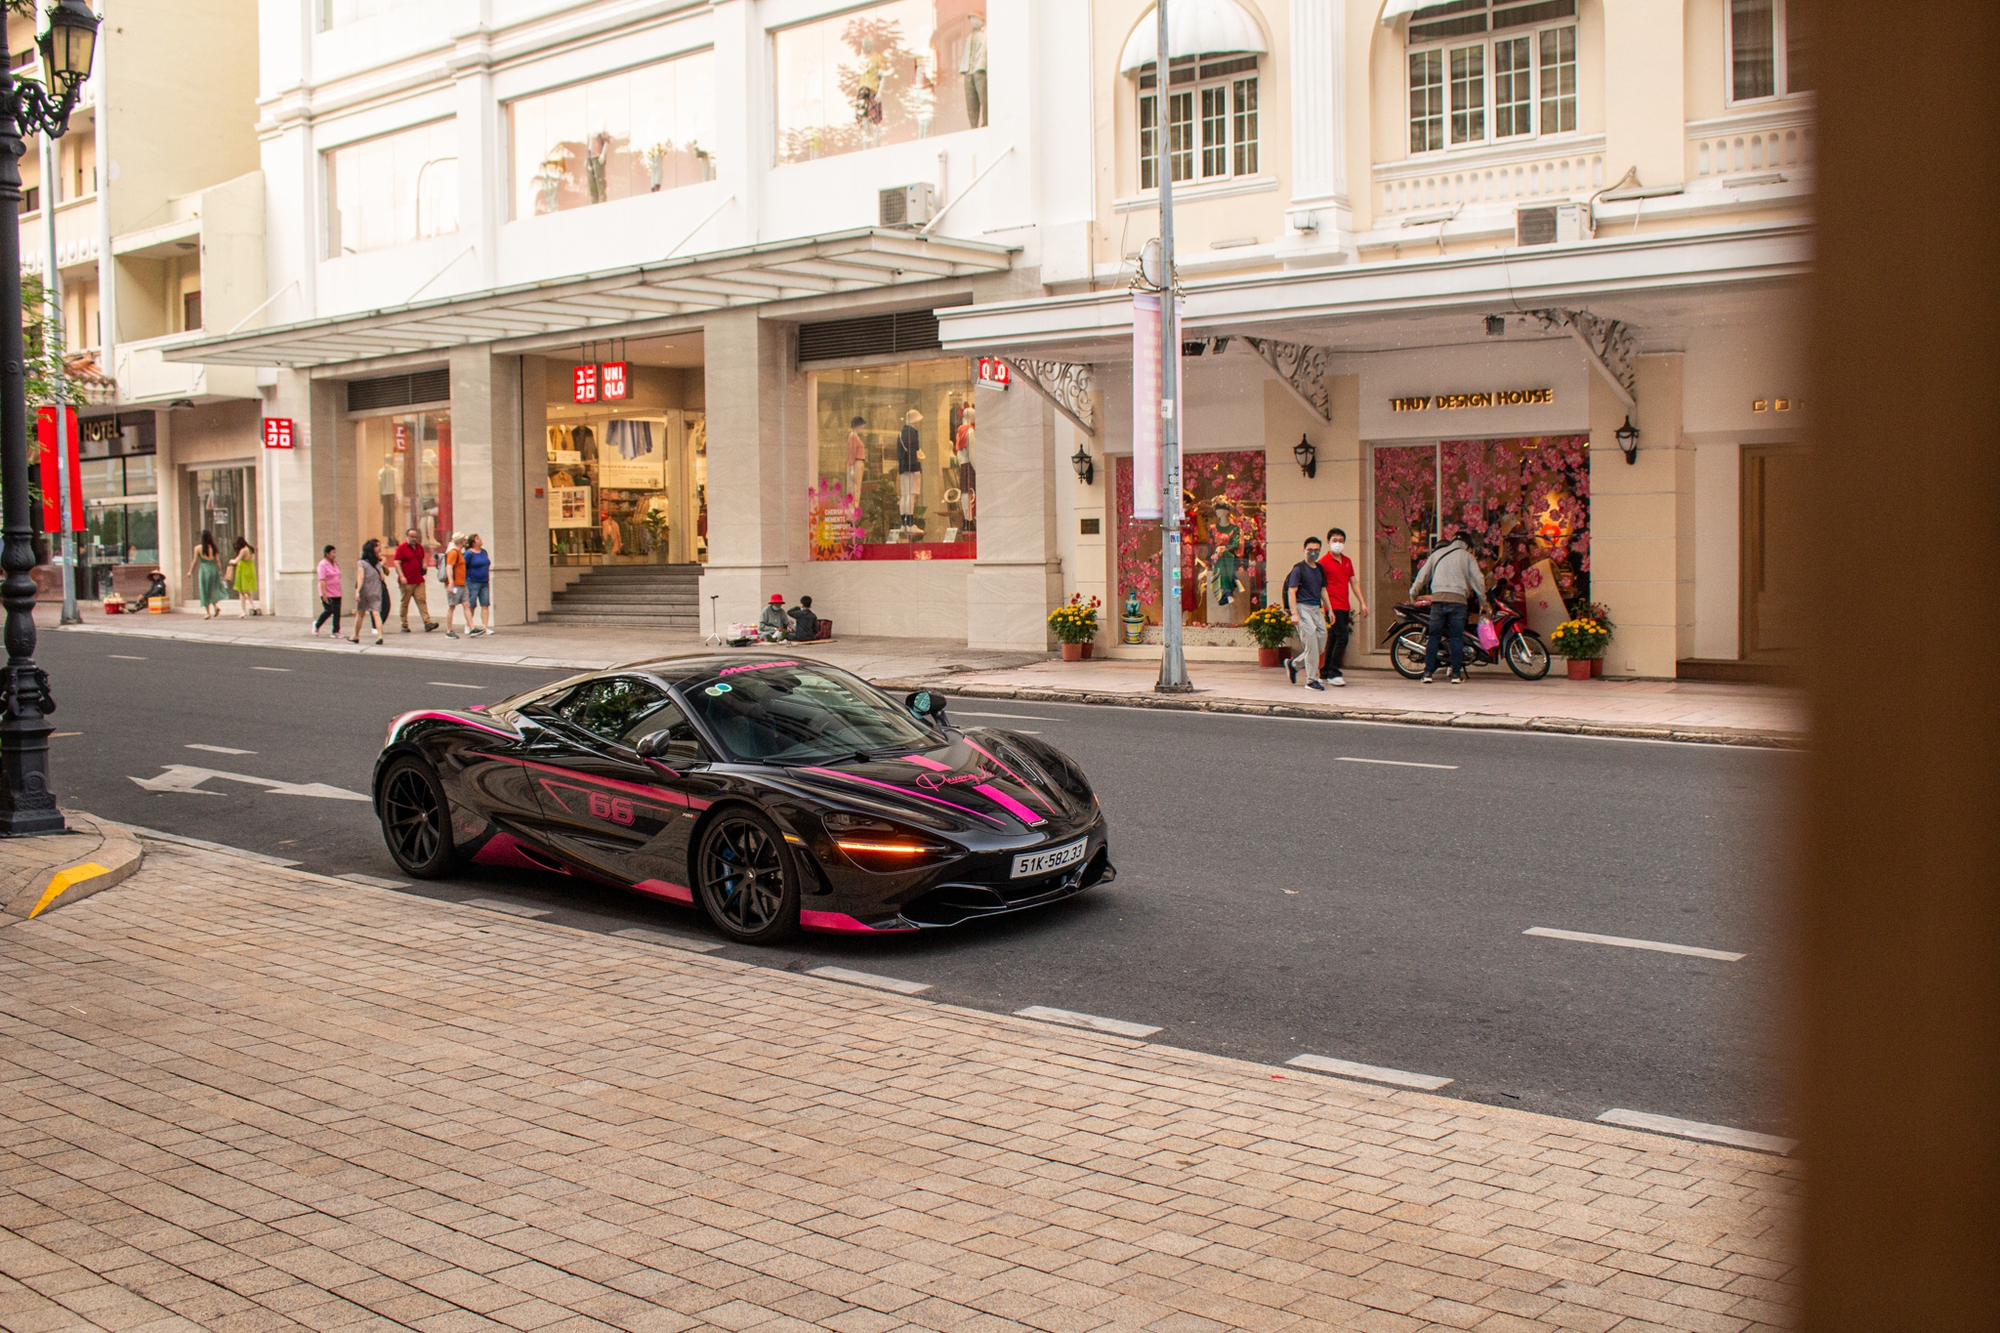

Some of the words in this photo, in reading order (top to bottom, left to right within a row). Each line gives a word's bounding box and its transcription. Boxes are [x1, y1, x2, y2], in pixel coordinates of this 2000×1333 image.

[604, 366, 623, 381] UNI
[981, 362, 1006, 381] QO
[604, 381, 625, 398] QLO
[1389, 396, 1432, 412] THUY
[1435, 392, 1495, 410] DESIGN
[1496, 388, 1554, 406] HOUSE
[83, 420, 120, 441] HOTEL
[719, 661, 799, 677] McLaren
[589, 790, 635, 827] 66
[1020, 844, 1083, 873] 51K-582.33
